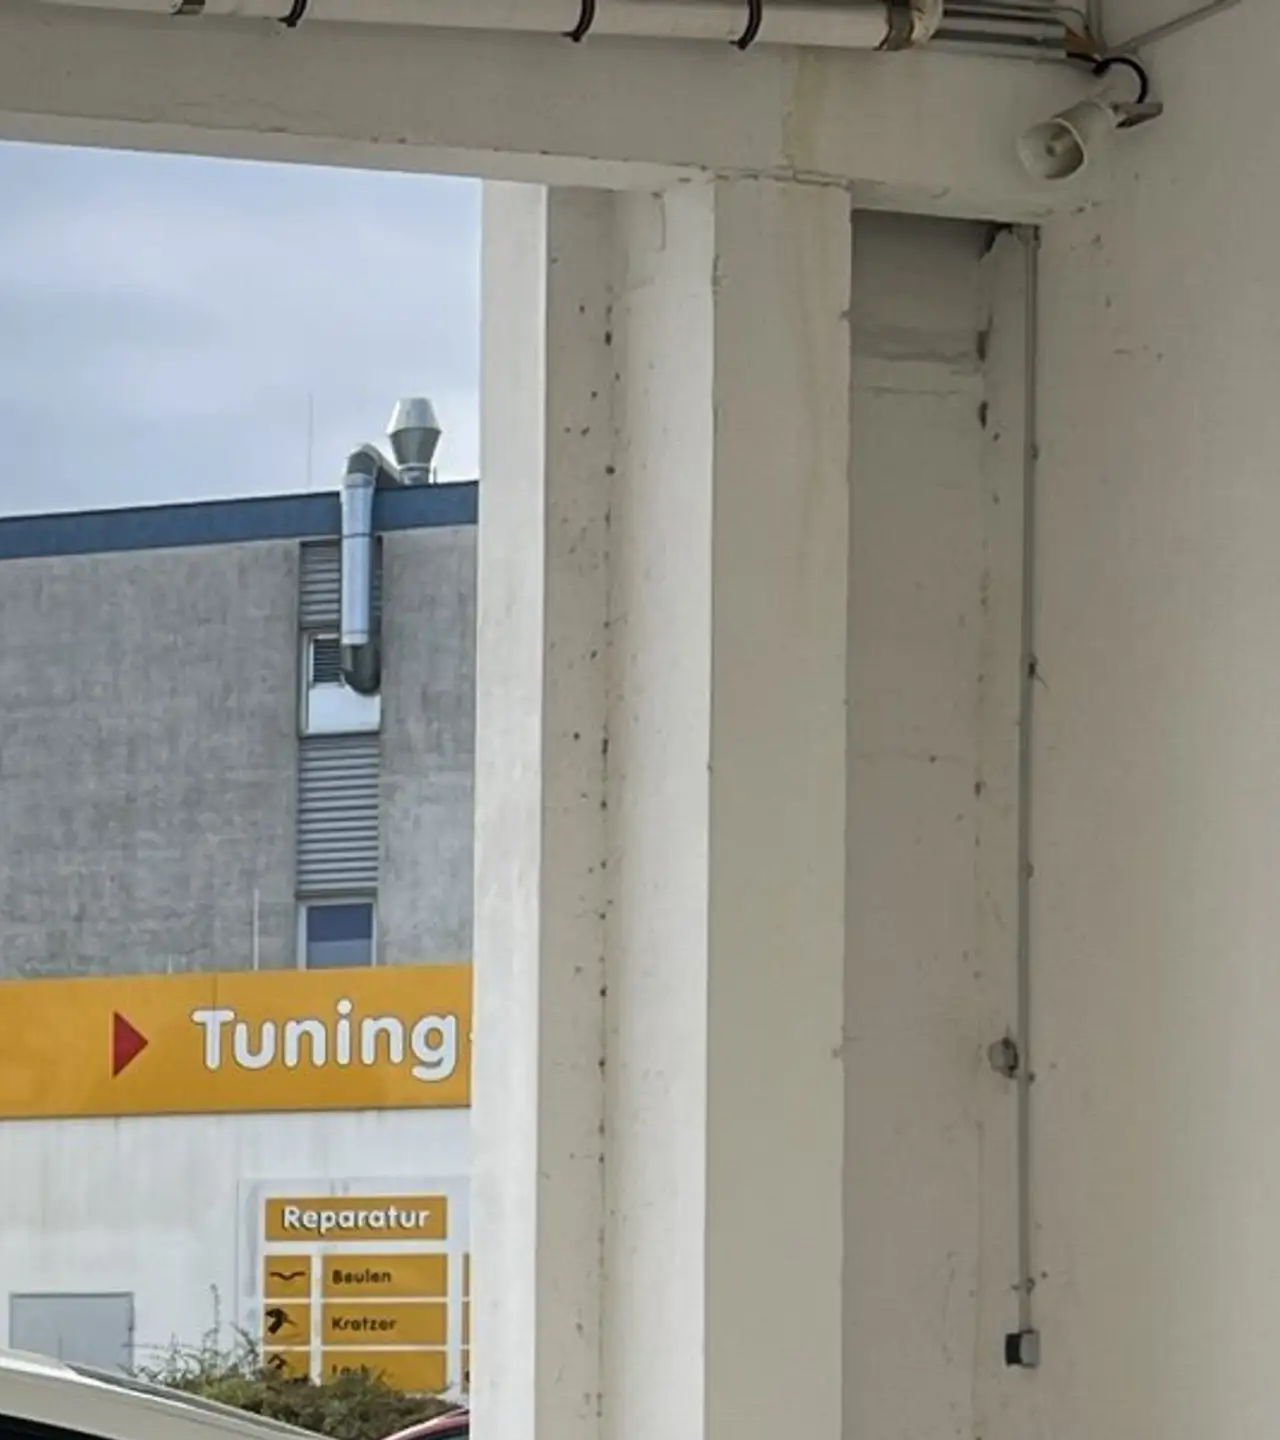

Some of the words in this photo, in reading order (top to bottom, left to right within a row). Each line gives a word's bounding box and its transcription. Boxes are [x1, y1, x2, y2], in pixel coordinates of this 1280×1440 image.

[190, 997, 458, 1082] Tuning
[281, 1204, 430, 1236] Reparatur
[331, 1269, 392, 1286] Beulen
[331, 1316, 397, 1332] Kratzer
